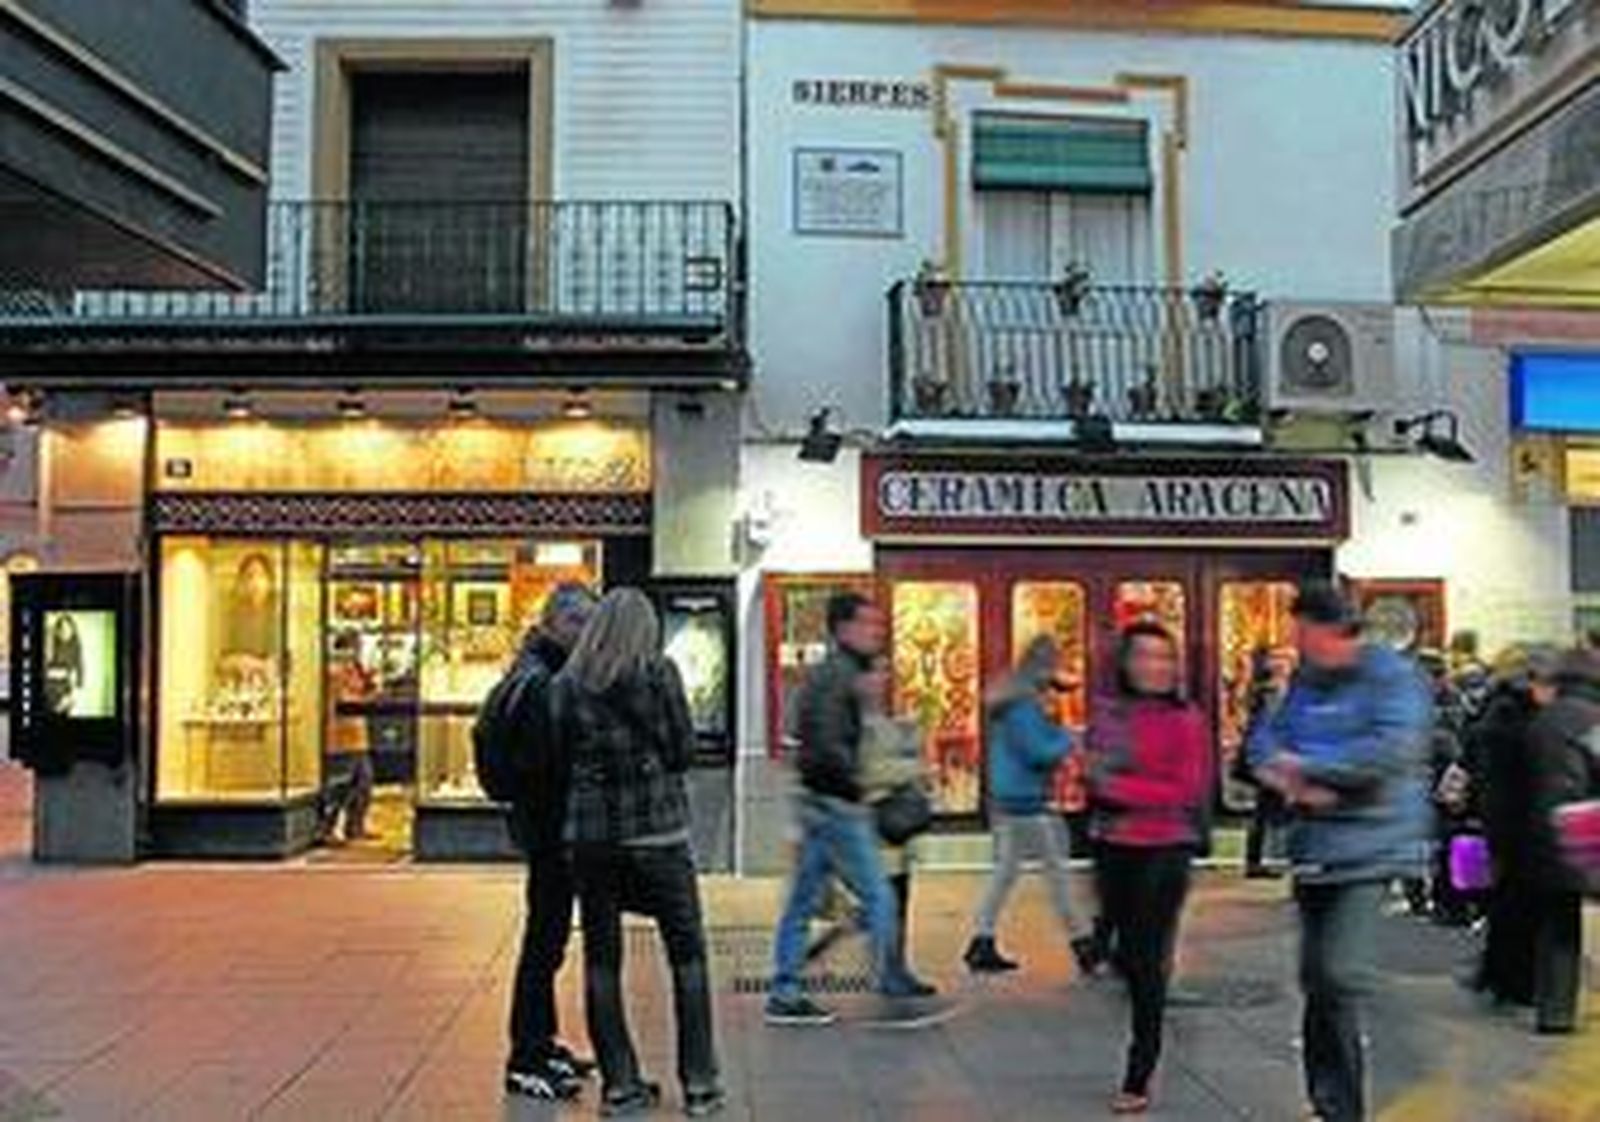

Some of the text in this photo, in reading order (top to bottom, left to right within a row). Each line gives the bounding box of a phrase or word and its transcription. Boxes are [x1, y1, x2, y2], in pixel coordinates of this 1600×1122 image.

[793, 80, 930, 109] SIERPES
[880, 475, 1331, 518] CERAMICA ARACENA
